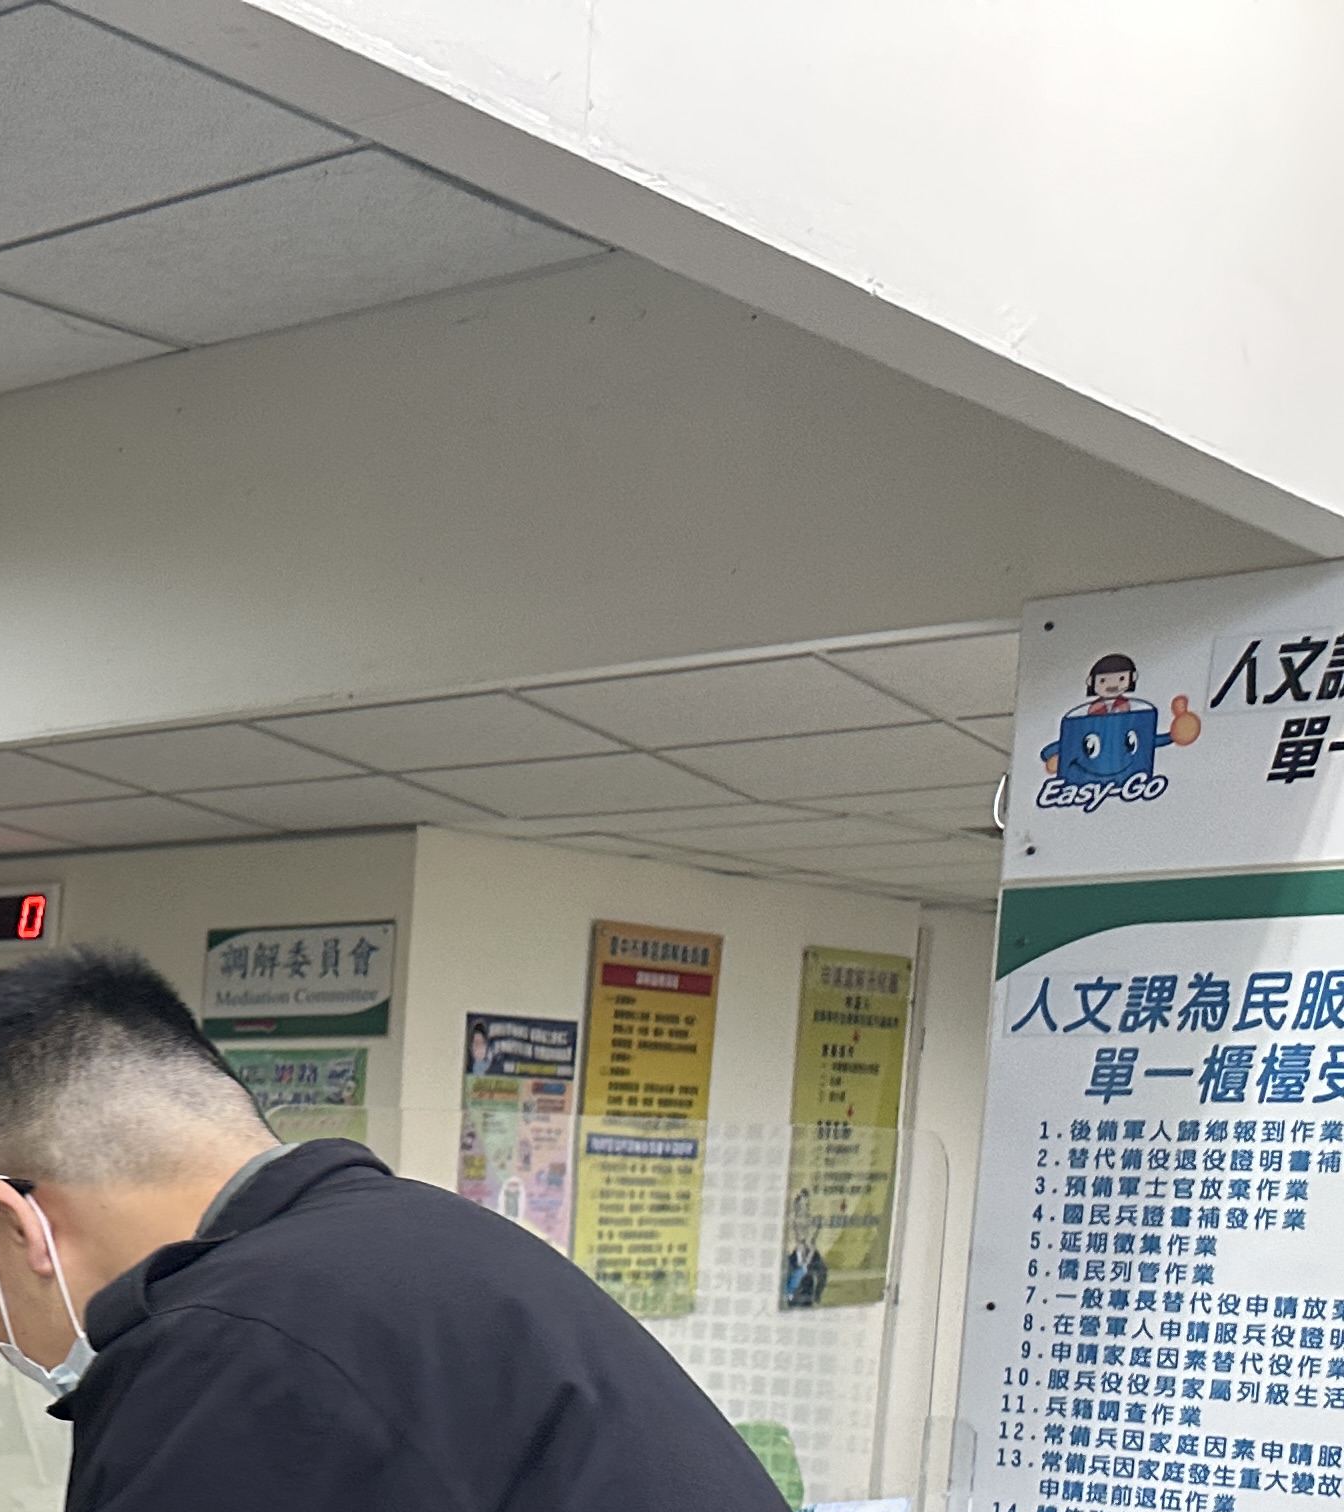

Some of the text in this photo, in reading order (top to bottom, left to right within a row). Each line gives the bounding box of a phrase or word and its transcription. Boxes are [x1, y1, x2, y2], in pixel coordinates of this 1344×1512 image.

[1036, 771, 1169, 813] Easy-Go
[16, 894, 47, 940] 0
[220, 935, 380, 979] 調解委員會
[1011, 969, 1344, 1033] 人文課為民服
